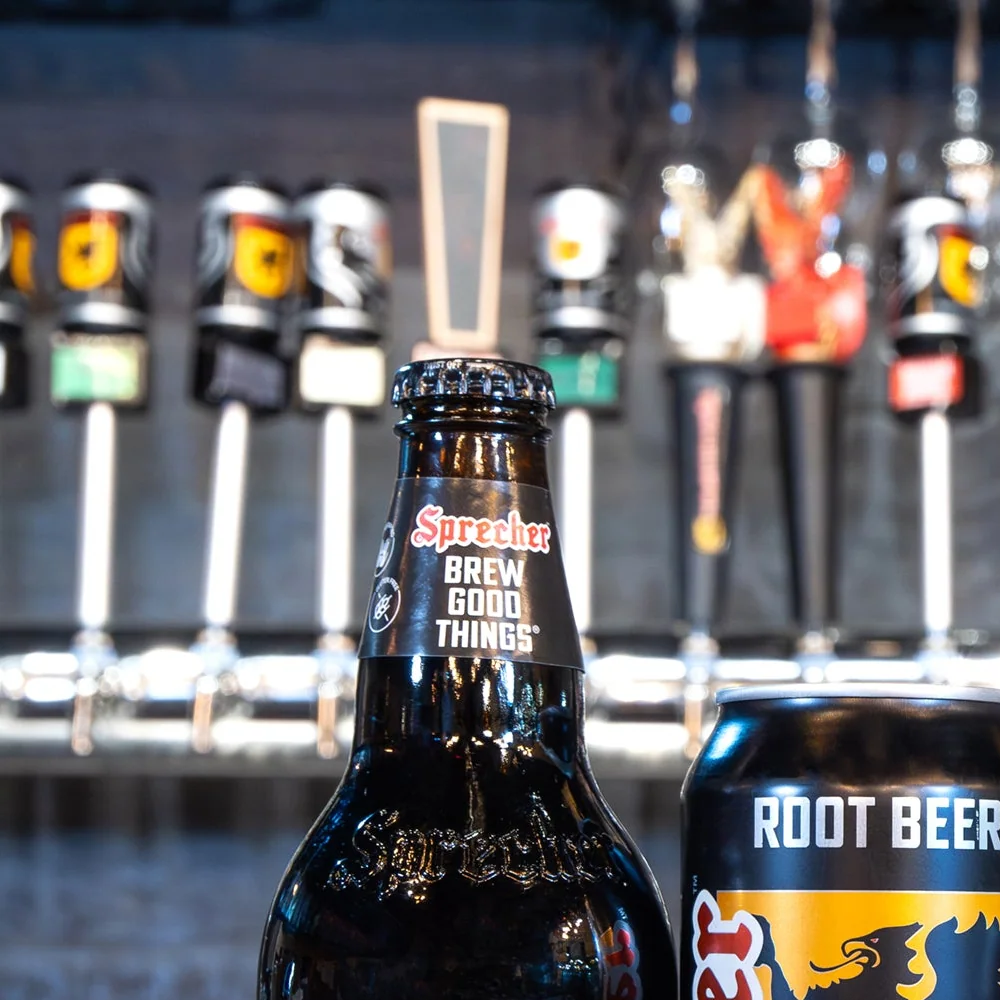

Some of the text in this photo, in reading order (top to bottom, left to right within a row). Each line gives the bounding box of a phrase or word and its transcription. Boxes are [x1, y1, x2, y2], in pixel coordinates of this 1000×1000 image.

[411, 505, 551, 554] Sprecher
[444, 556, 524, 587] BREW
[448, 588, 521, 618] GOOD
[754, 796, 875, 848] ROOT
